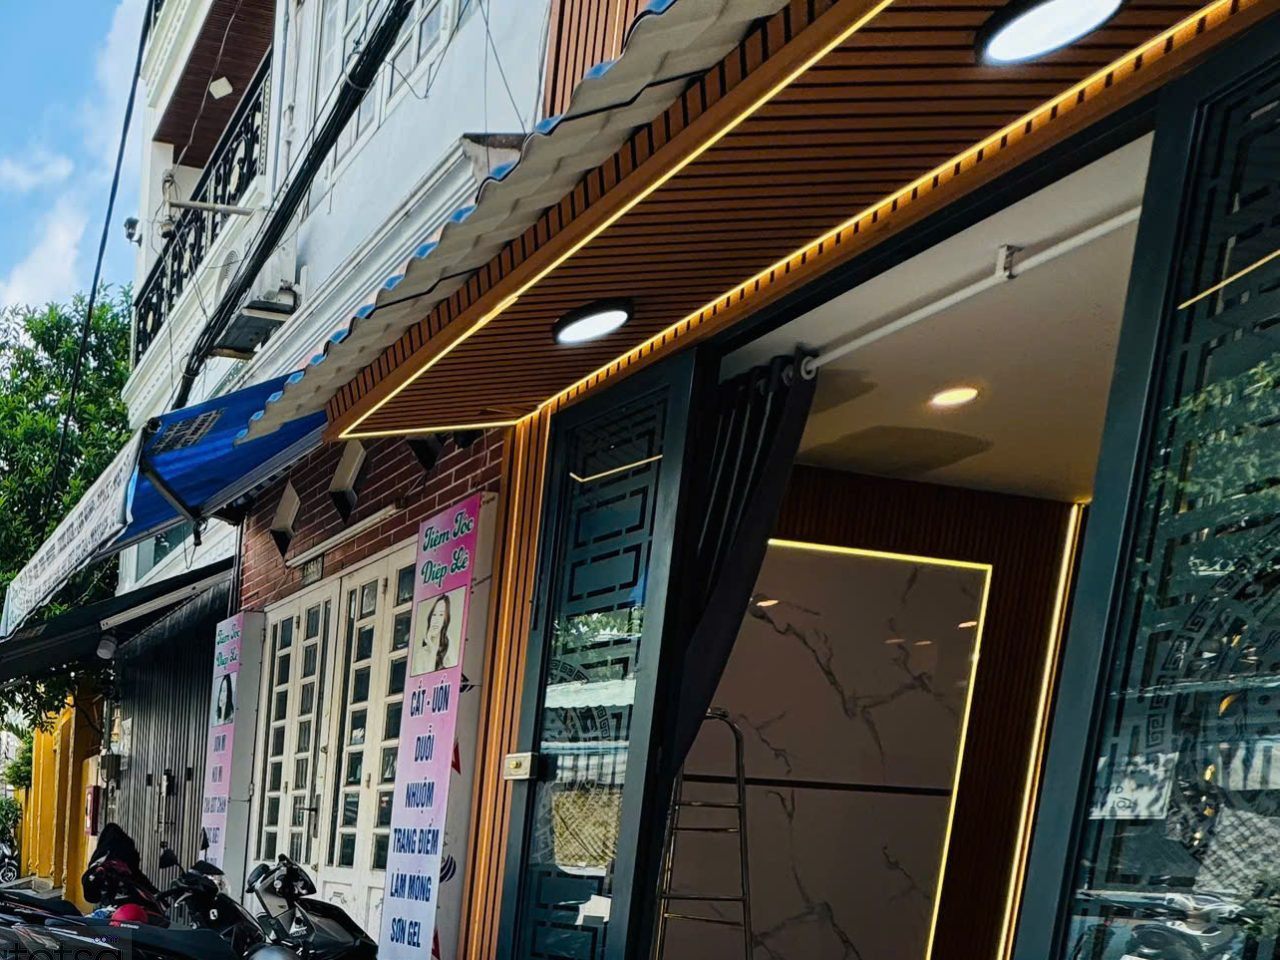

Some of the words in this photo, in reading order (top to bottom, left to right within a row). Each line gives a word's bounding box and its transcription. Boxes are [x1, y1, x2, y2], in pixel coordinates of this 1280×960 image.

[423, 526, 450, 552] Tiệm
[453, 511, 473, 538] Tóc
[421, 560, 448, 587] Diệp
[450, 547, 468, 573] Lê
[410, 680, 426, 717] CẮT
[432, 675, 450, 713] UỐN
[405, 777, 435, 814] NHUỘM
[393, 828, 417, 854] TRANG
[417, 817, 439, 855] ĐIỂM
[390, 868, 407, 899] LÀM
[407, 869, 431, 902] MÓNG
[390, 917, 406, 945] SƠN
[407, 920, 422, 948] GEL
